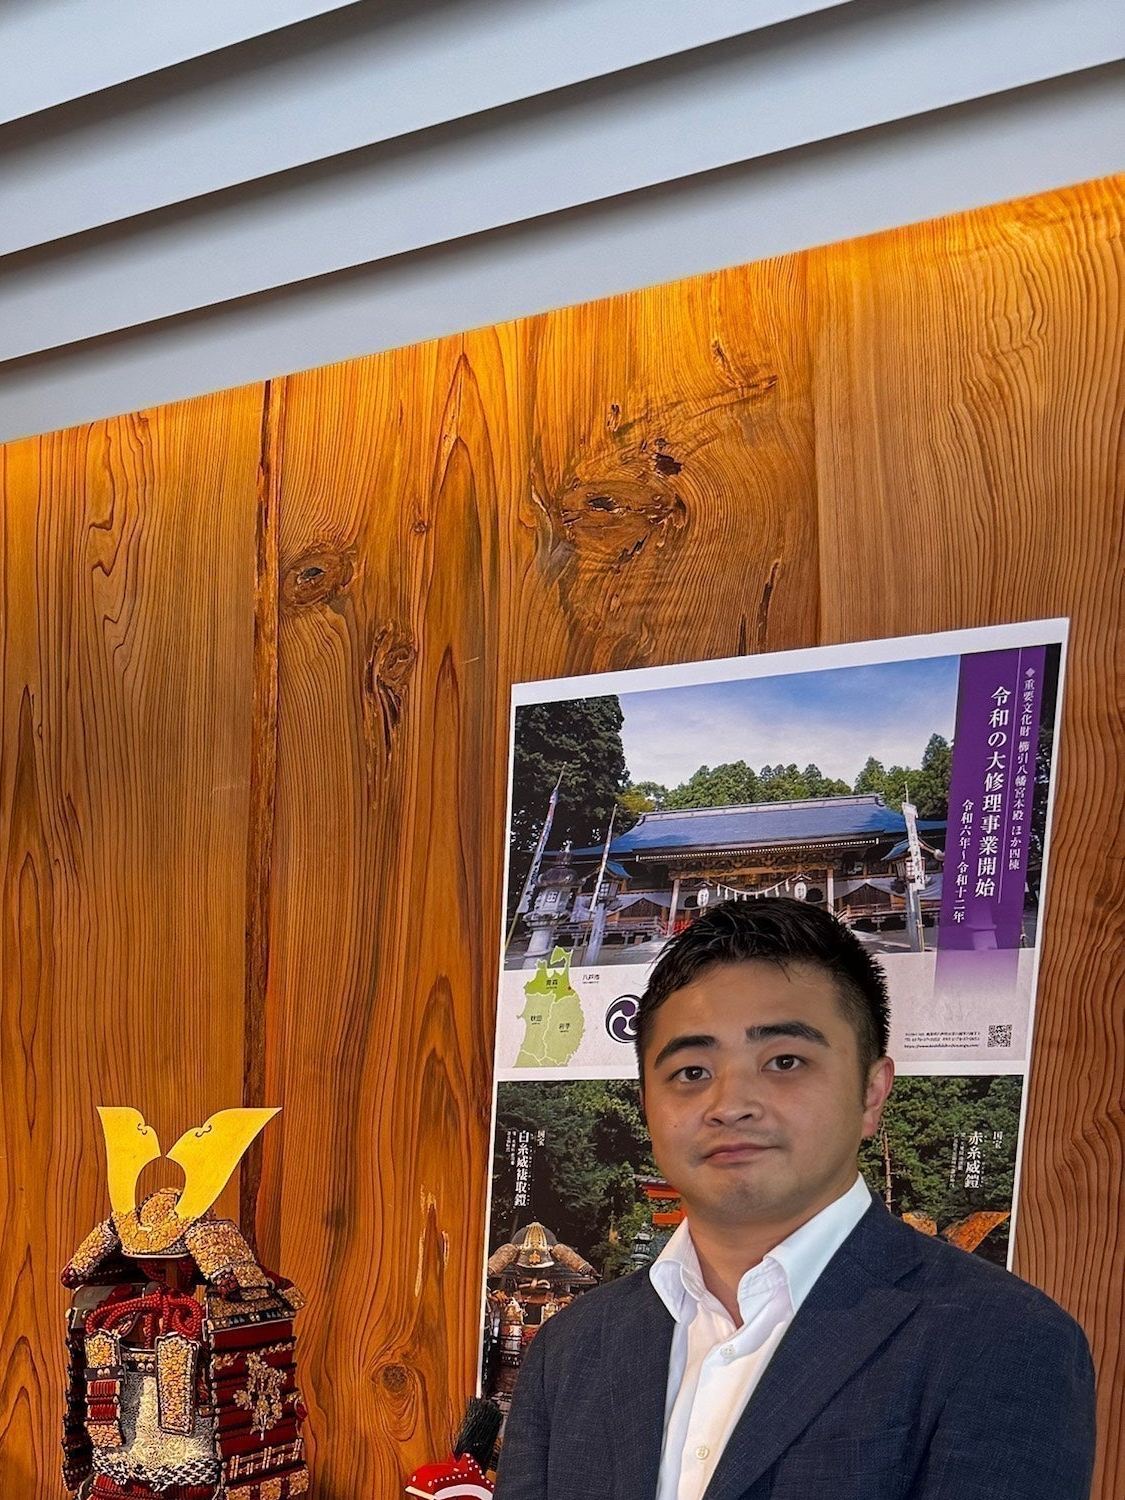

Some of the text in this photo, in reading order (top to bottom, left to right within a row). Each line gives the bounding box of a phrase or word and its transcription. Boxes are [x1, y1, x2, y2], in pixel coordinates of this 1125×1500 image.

[974, 685, 1012, 899] 令和の大修理事業開始
